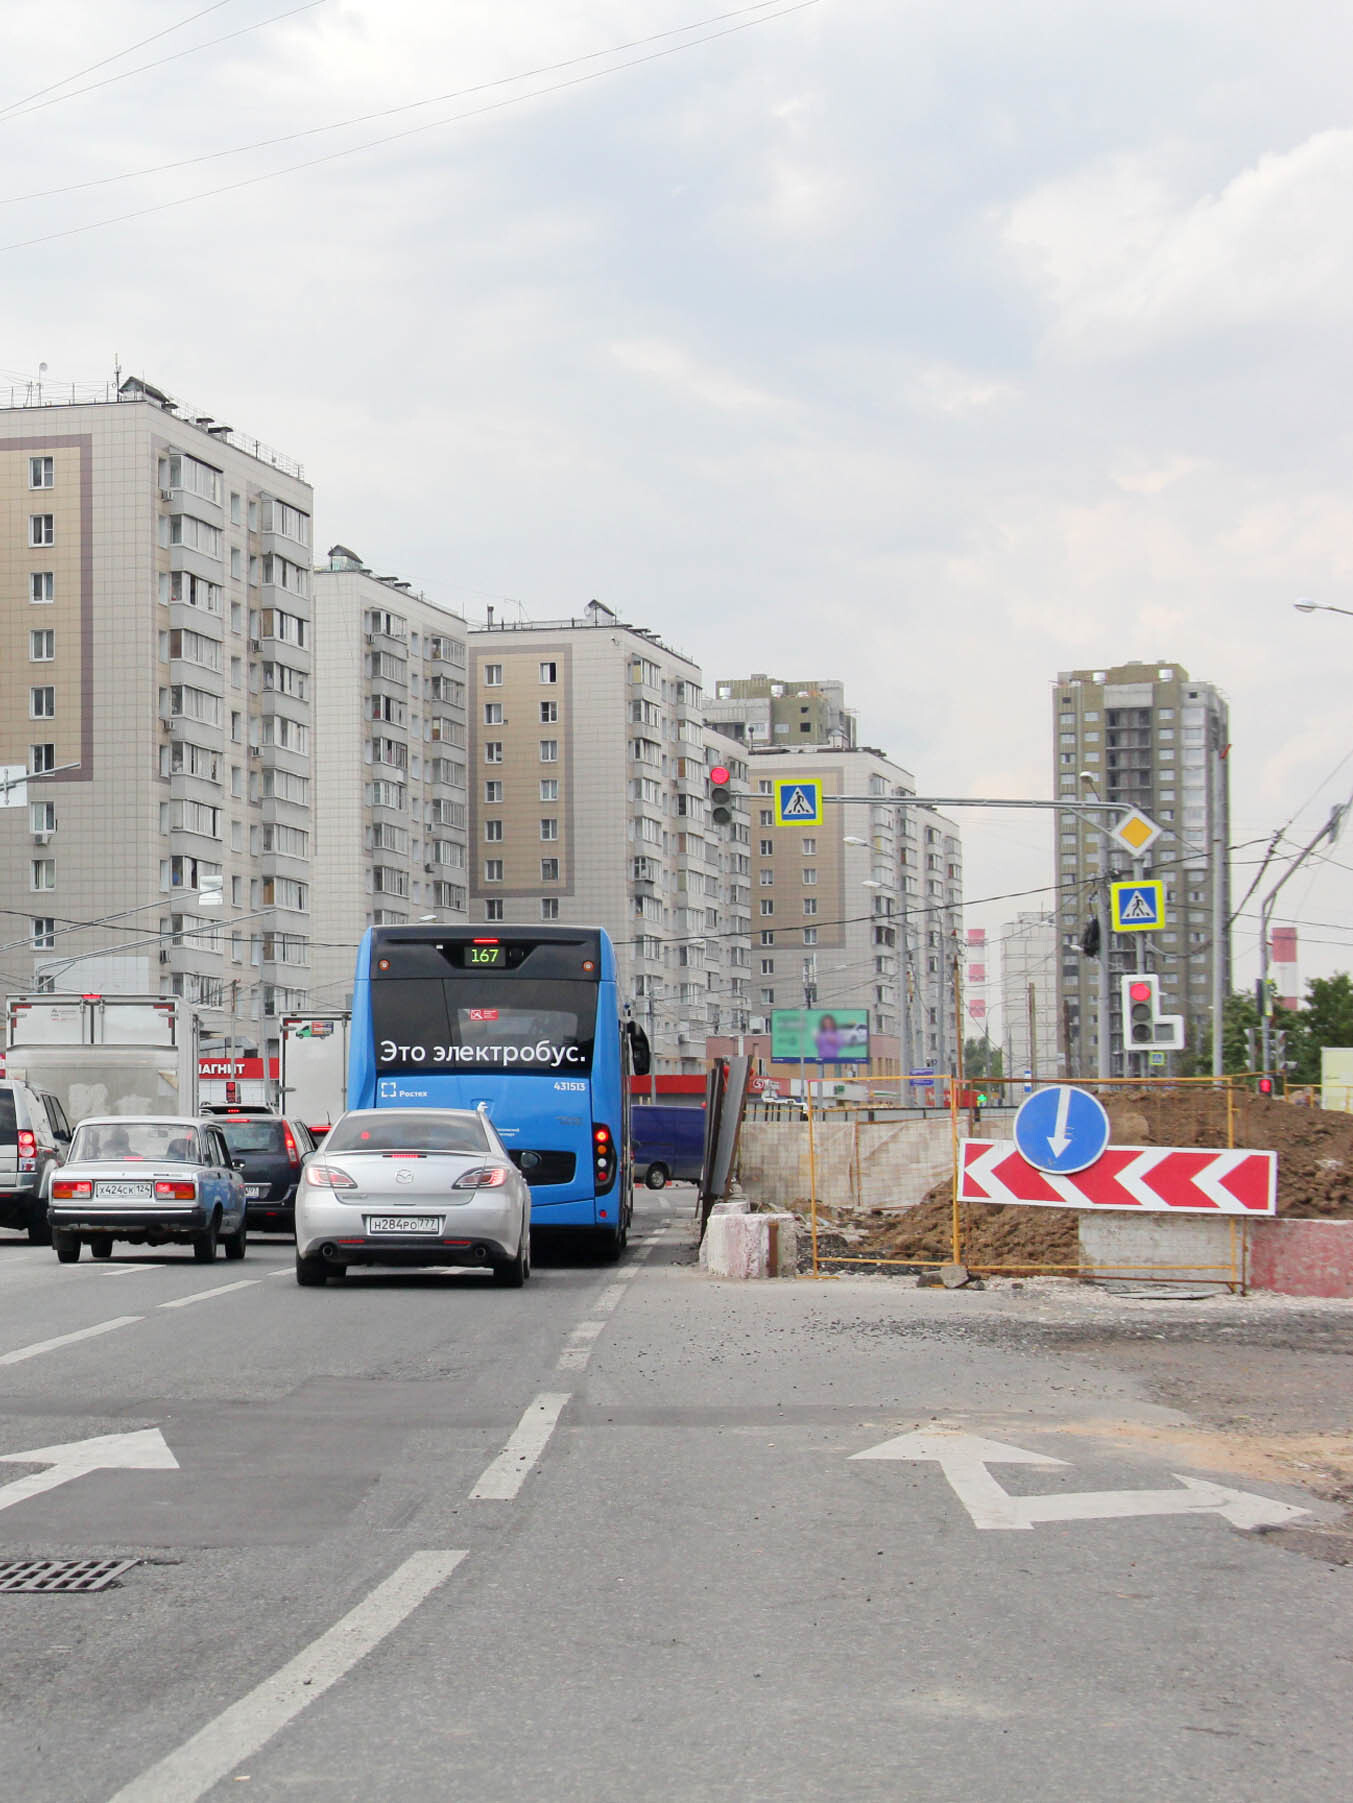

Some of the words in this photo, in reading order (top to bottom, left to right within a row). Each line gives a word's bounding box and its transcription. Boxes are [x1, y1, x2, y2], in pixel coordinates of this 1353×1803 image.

[471, 948, 500, 962] 167
[380, 1040, 426, 1062] Это
[433, 1040, 586, 1067] электробус.
[553, 1082, 586, 1092] 431513
[399, 1090, 428, 1098] Ростех
